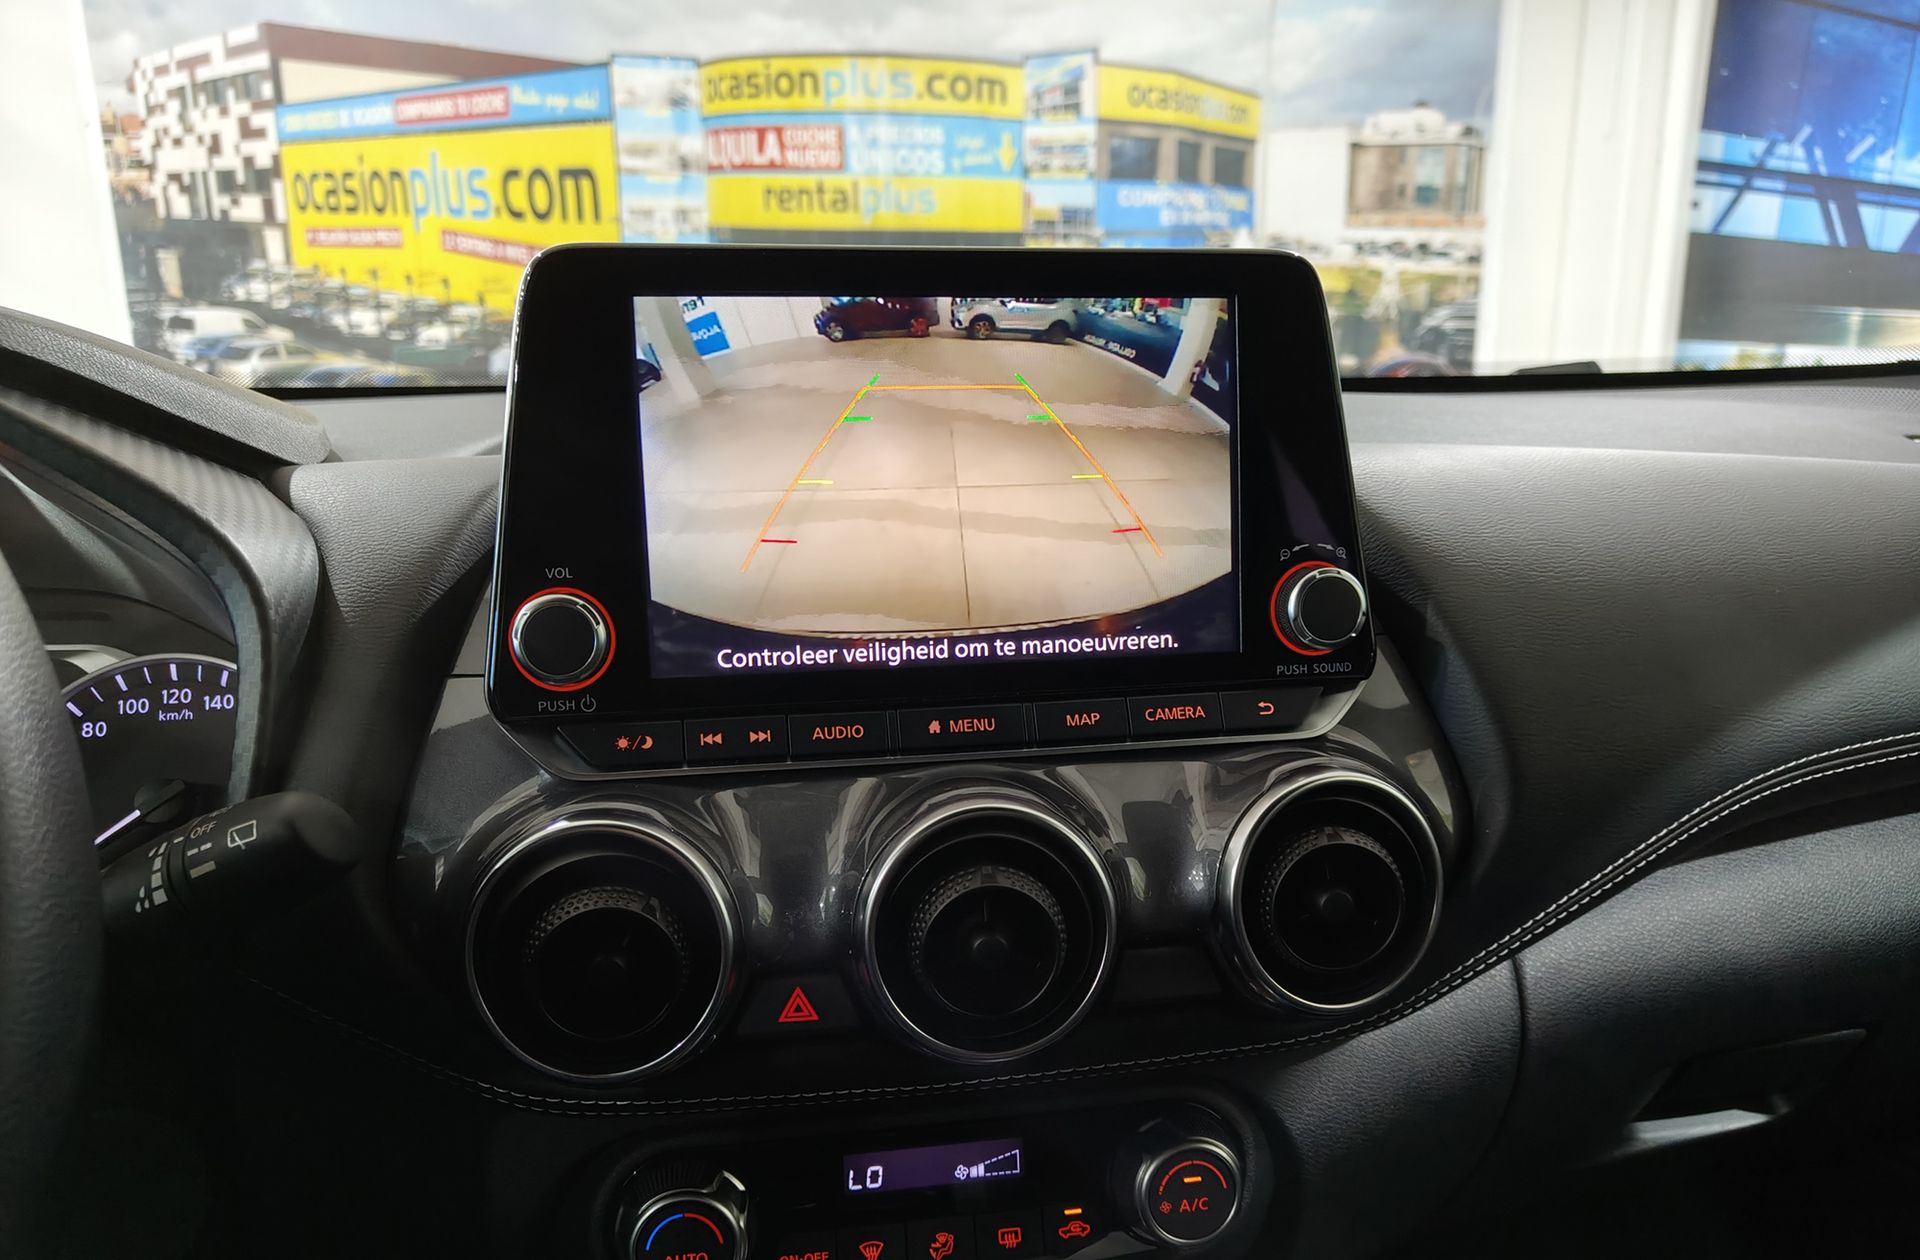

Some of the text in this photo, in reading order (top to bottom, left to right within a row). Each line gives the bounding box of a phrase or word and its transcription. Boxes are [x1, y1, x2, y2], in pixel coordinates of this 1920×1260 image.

[292, 151, 601, 232] ocasionplus.com
[762, 180, 938, 224] rentalplus
[545, 567, 573, 579] VOL
[717, 633, 1179, 668] Controleer veiligheid om te manoeuvreren.
[1276, 662, 1352, 675] PUSH SOUND
[161, 688, 192, 705] 120
[203, 694, 235, 711] 140
[117, 698, 150, 715] 100
[538, 699, 576, 712] PUSH
[1145, 705, 1206, 721] CAMERA
[158, 708, 194, 722] km/h
[1066, 712, 1100, 728] MAP
[81, 721, 107, 738] 80
[812, 724, 864, 740] AUDIO
[949, 718, 995, 733] MENU
[190, 820, 217, 839] OFF
[848, 1165, 884, 1191] LO
[1179, 1197, 1209, 1213] A/C
